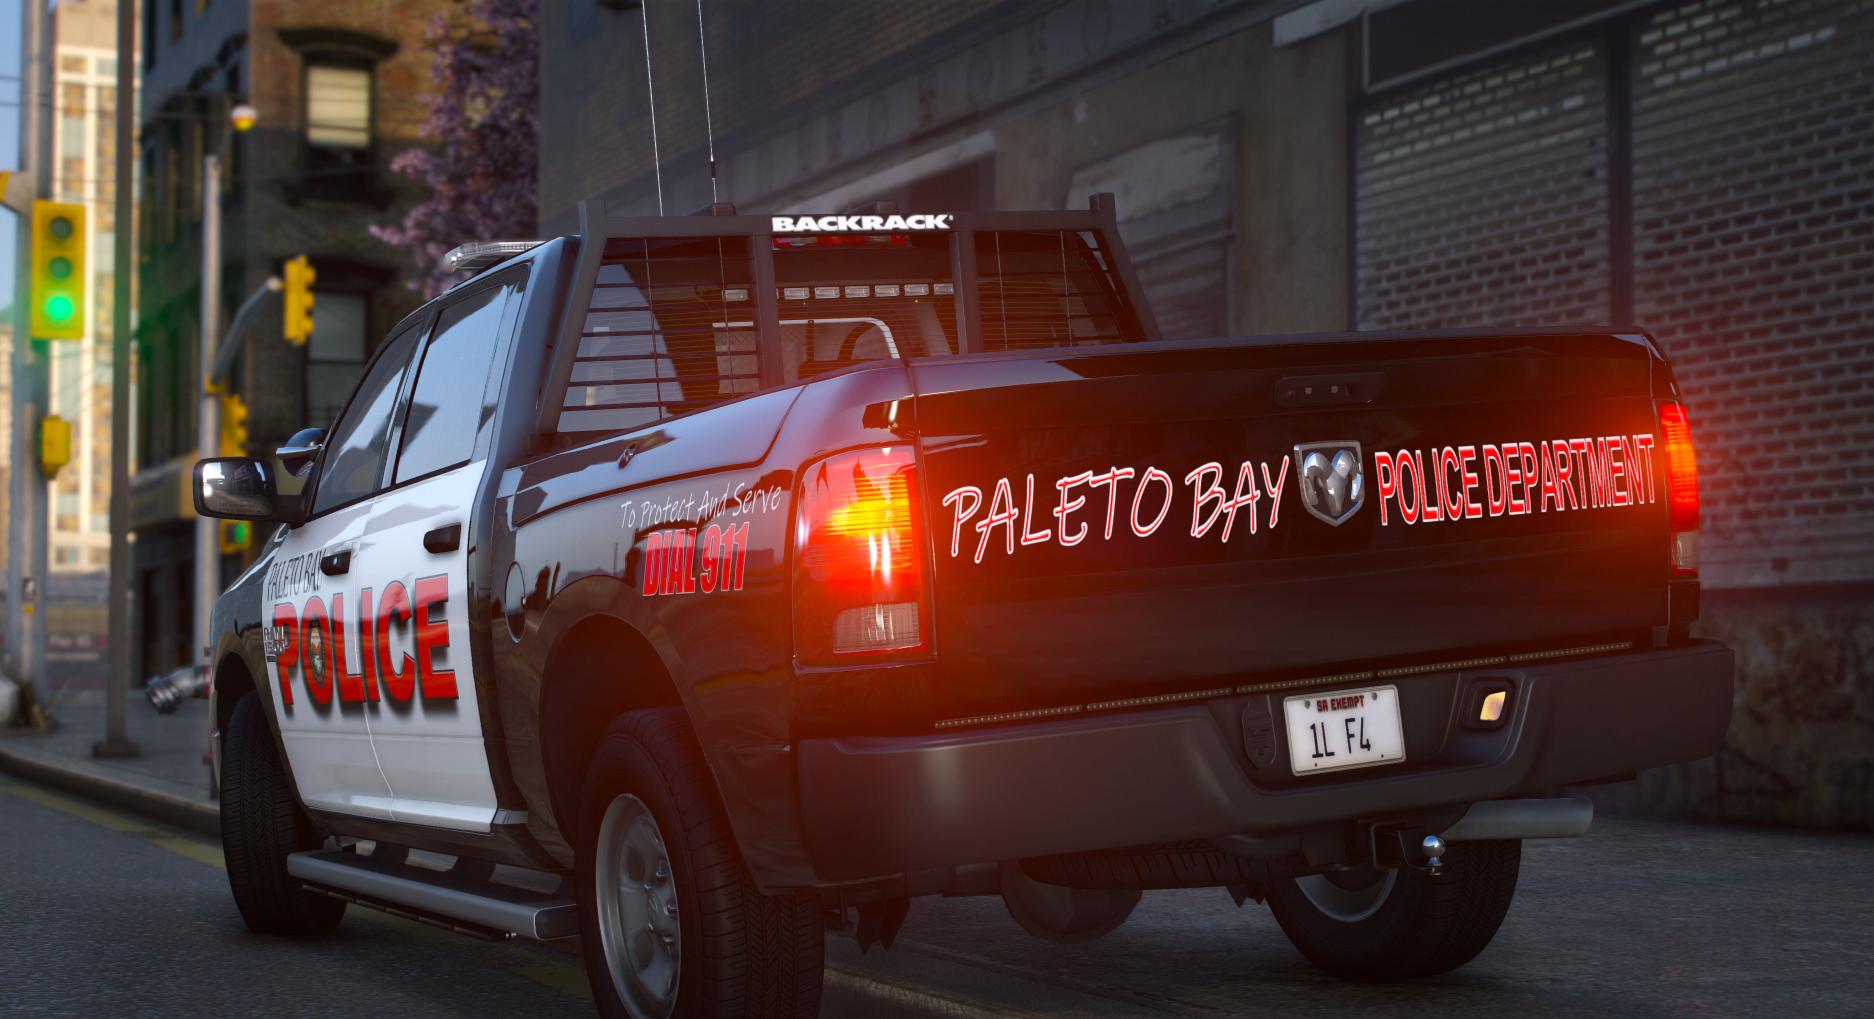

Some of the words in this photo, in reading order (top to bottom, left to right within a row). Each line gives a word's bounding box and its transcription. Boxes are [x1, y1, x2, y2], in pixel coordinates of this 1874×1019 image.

[772, 214, 952, 232] BACKRACK
[620, 500, 636, 528] To
[640, 492, 695, 528] Protect
[696, 480, 730, 524] And
[732, 482, 782, 517] Serve
[943, 466, 1173, 563] PALETO
[1185, 455, 1290, 542] BAY
[1375, 445, 1483, 526] POLICE
[1482, 434, 1655, 517] DEPARTMENT
[642, 527, 697, 597] DIAL
[700, 521, 750, 594] 911
[273, 573, 459, 705] POLICE
[1331, 694, 1364, 711] EXEMPT
[1345, 716, 1371, 754] F4
